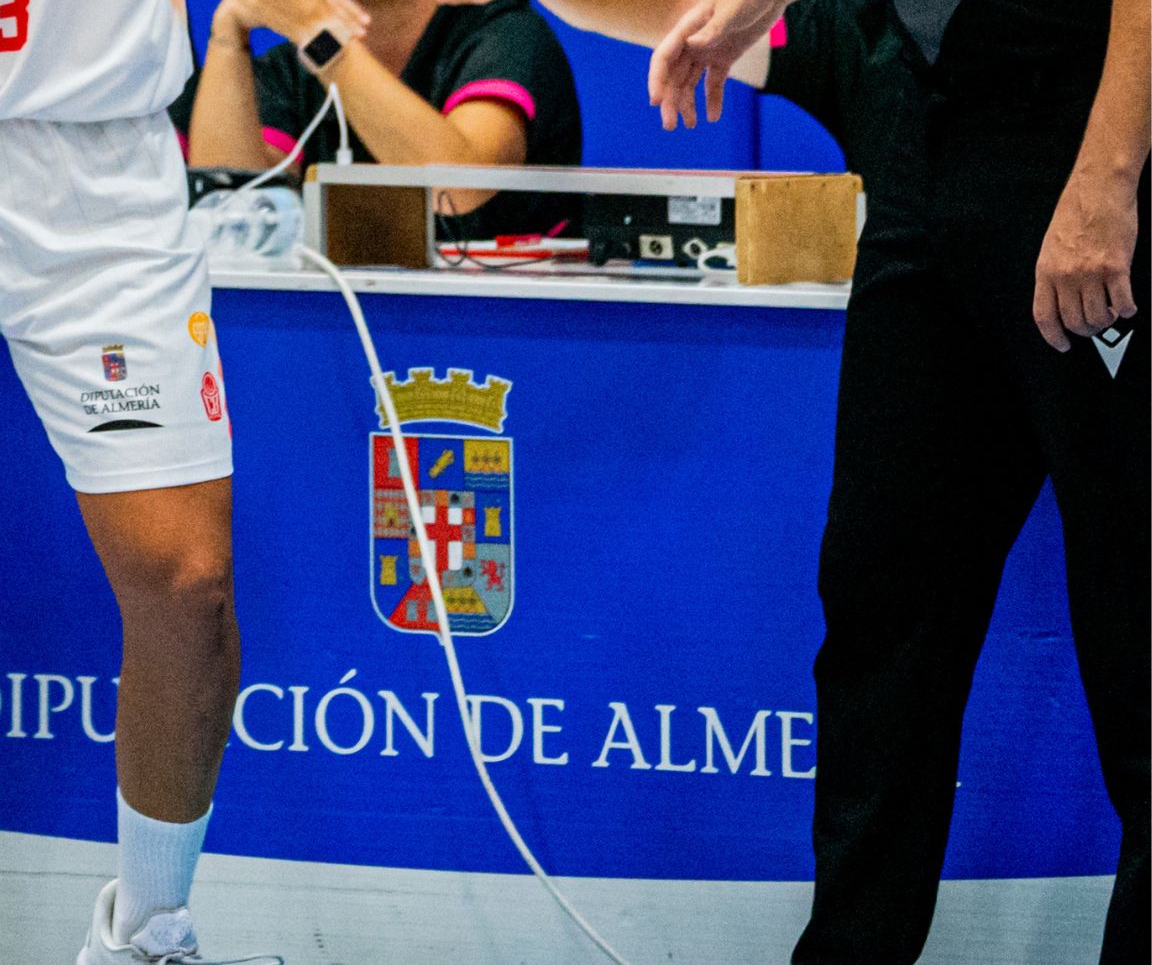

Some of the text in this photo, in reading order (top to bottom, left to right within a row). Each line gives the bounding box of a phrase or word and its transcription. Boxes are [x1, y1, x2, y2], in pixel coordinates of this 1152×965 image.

[80, 384, 161, 403] DIPUTACIÓN
[84, 397, 161, 416] DE ALMERÍA
[464, 693, 570, 766] DE
